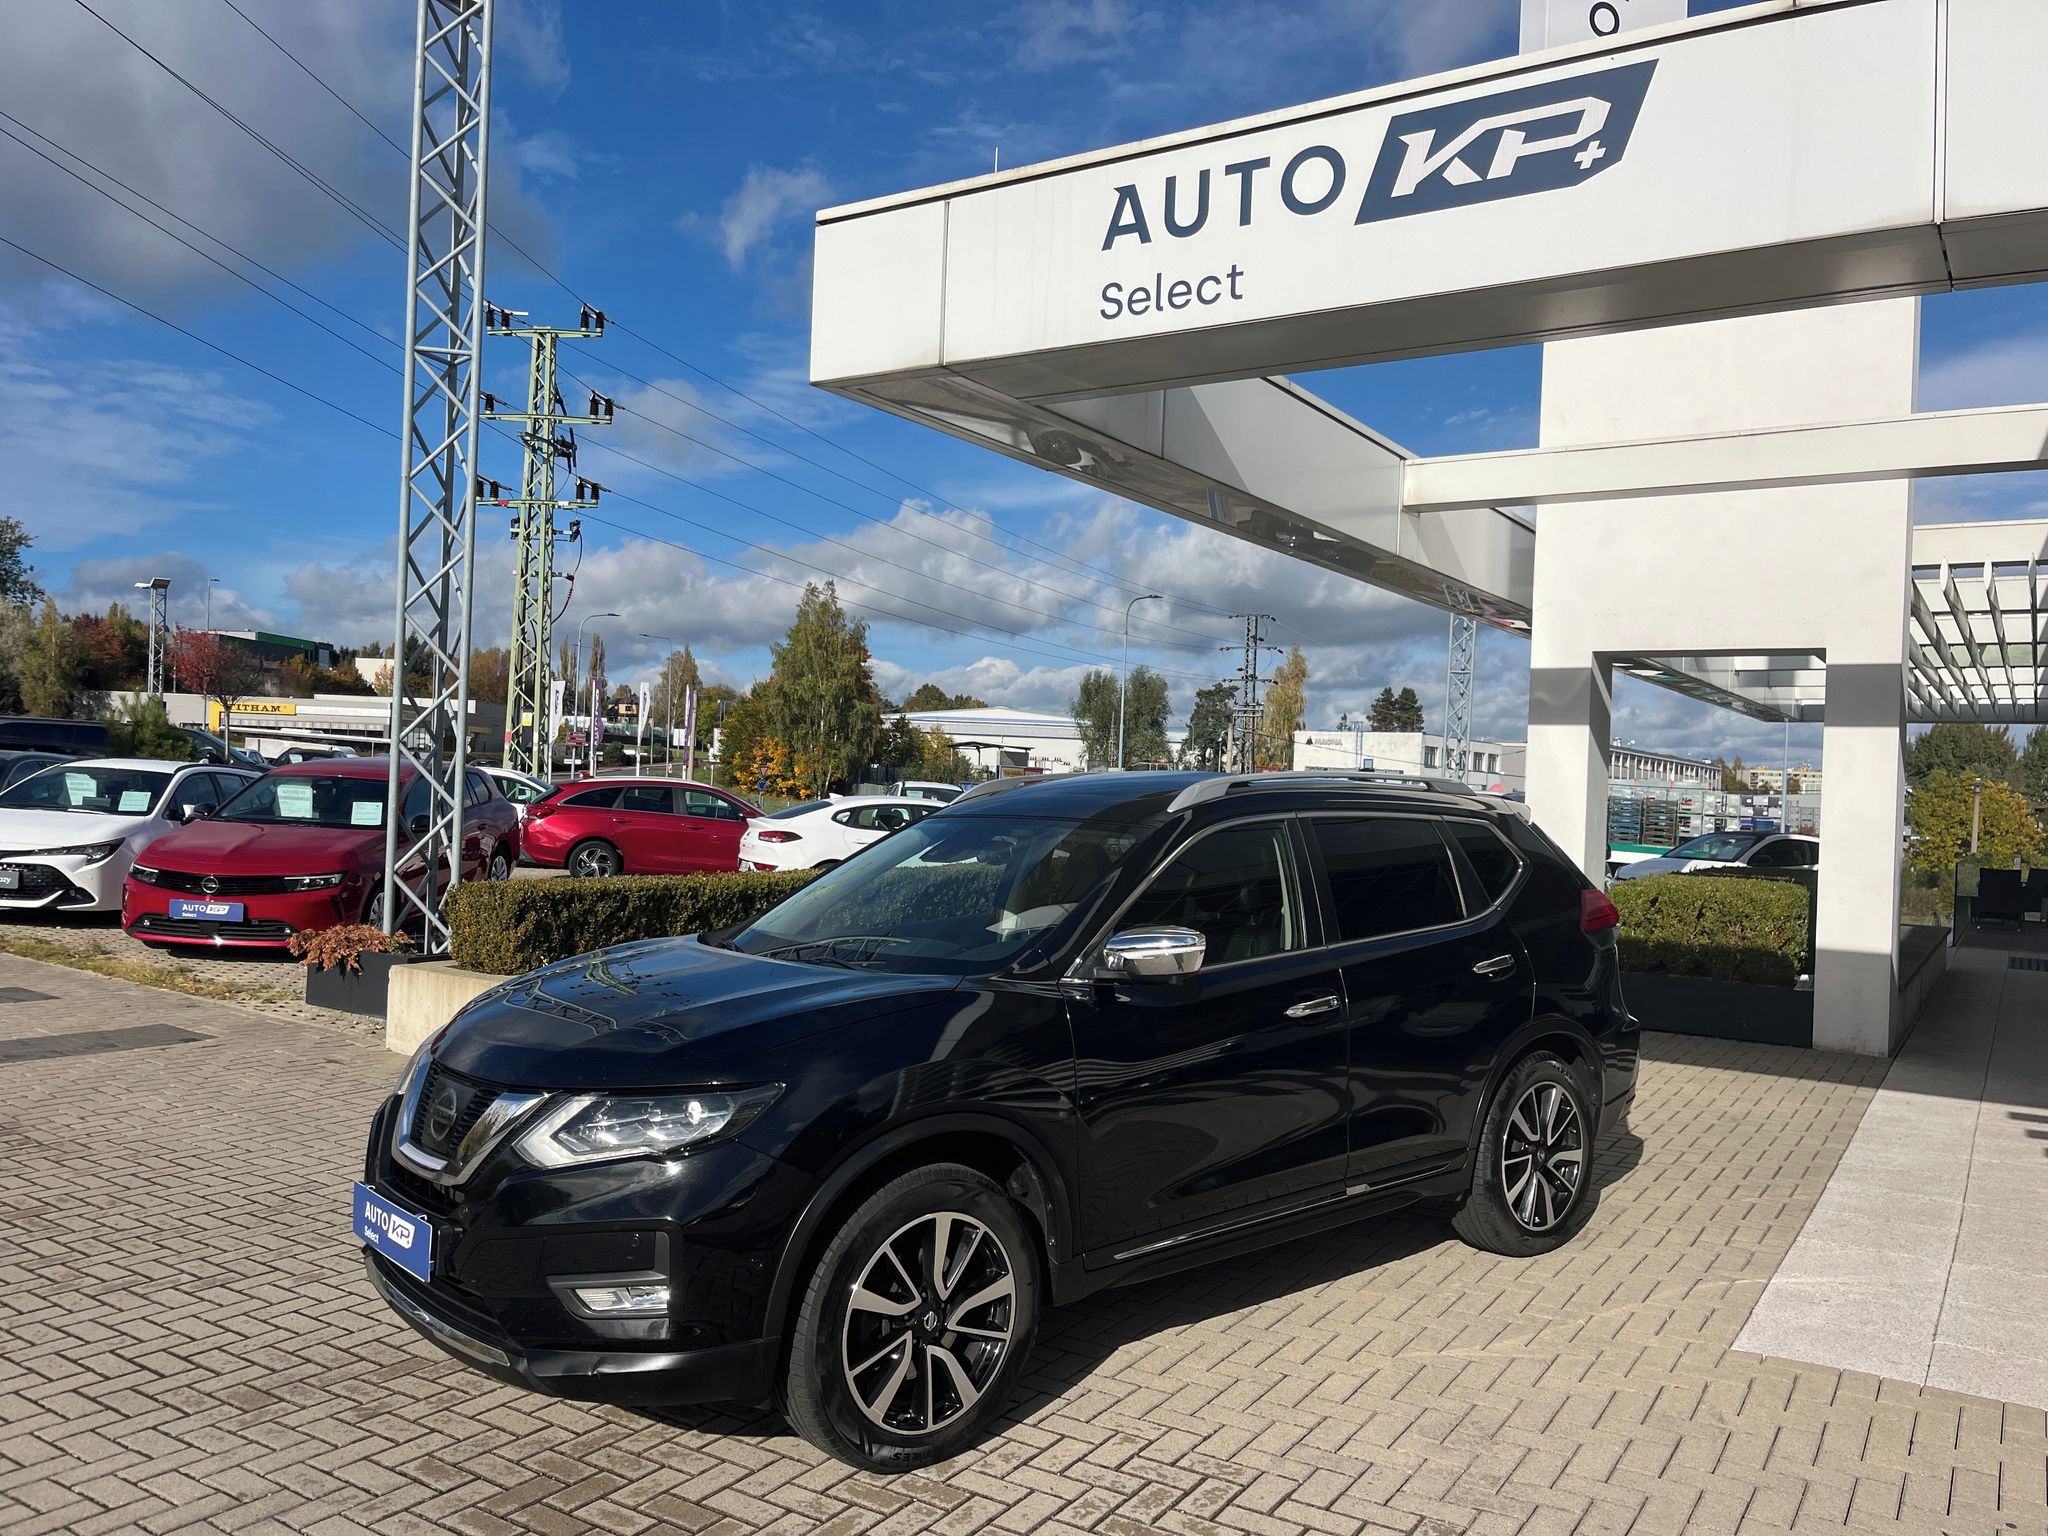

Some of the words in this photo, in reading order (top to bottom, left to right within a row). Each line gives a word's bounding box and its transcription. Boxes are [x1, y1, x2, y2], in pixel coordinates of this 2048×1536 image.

[1101, 145, 1346, 251] AUTO
[1100, 264, 1244, 320] Select
[182, 904, 206, 912] AUTO
[364, 1201, 389, 1231] AUTO
[364, 1225, 380, 1244] Select
